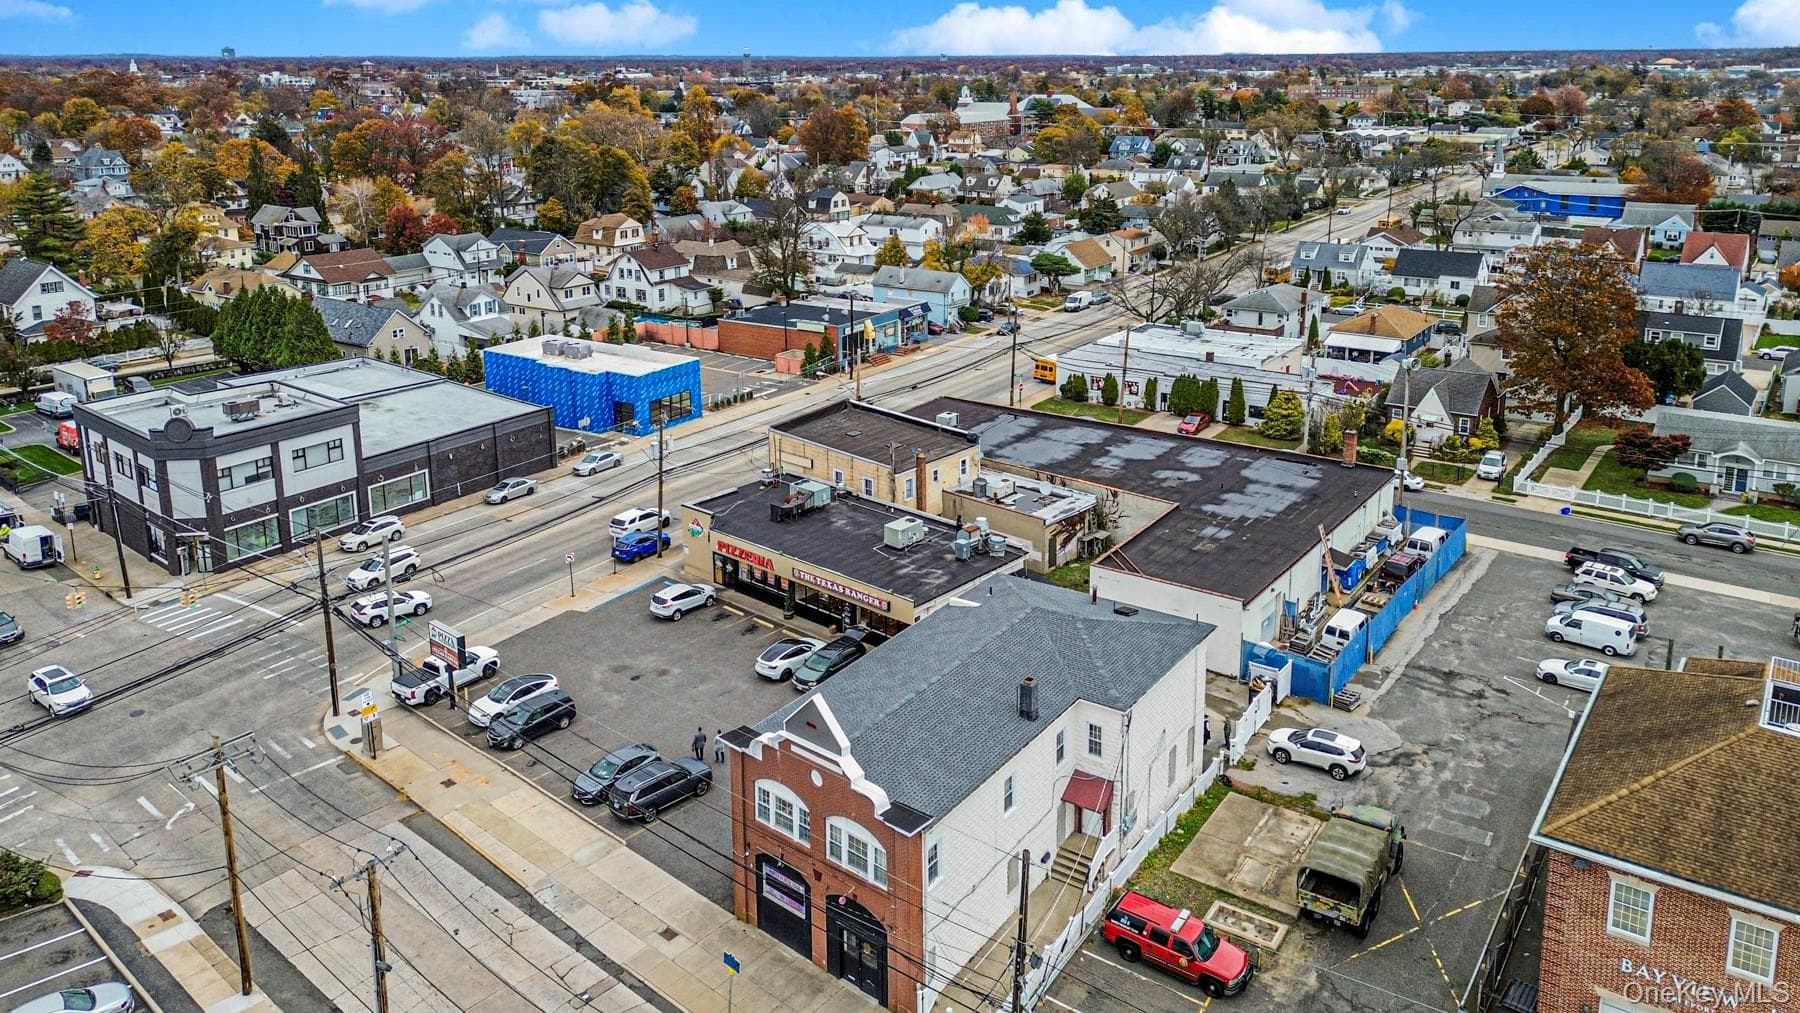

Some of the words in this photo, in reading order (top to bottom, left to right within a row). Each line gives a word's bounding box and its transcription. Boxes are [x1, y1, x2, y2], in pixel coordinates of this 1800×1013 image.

[717, 540, 775, 571] PIZZERIA
[800, 571, 815, 585] THE
[816, 577, 844, 593] TEXAS
[845, 587, 880, 607] RANGER
[1621, 957, 1666, 984] BAY
